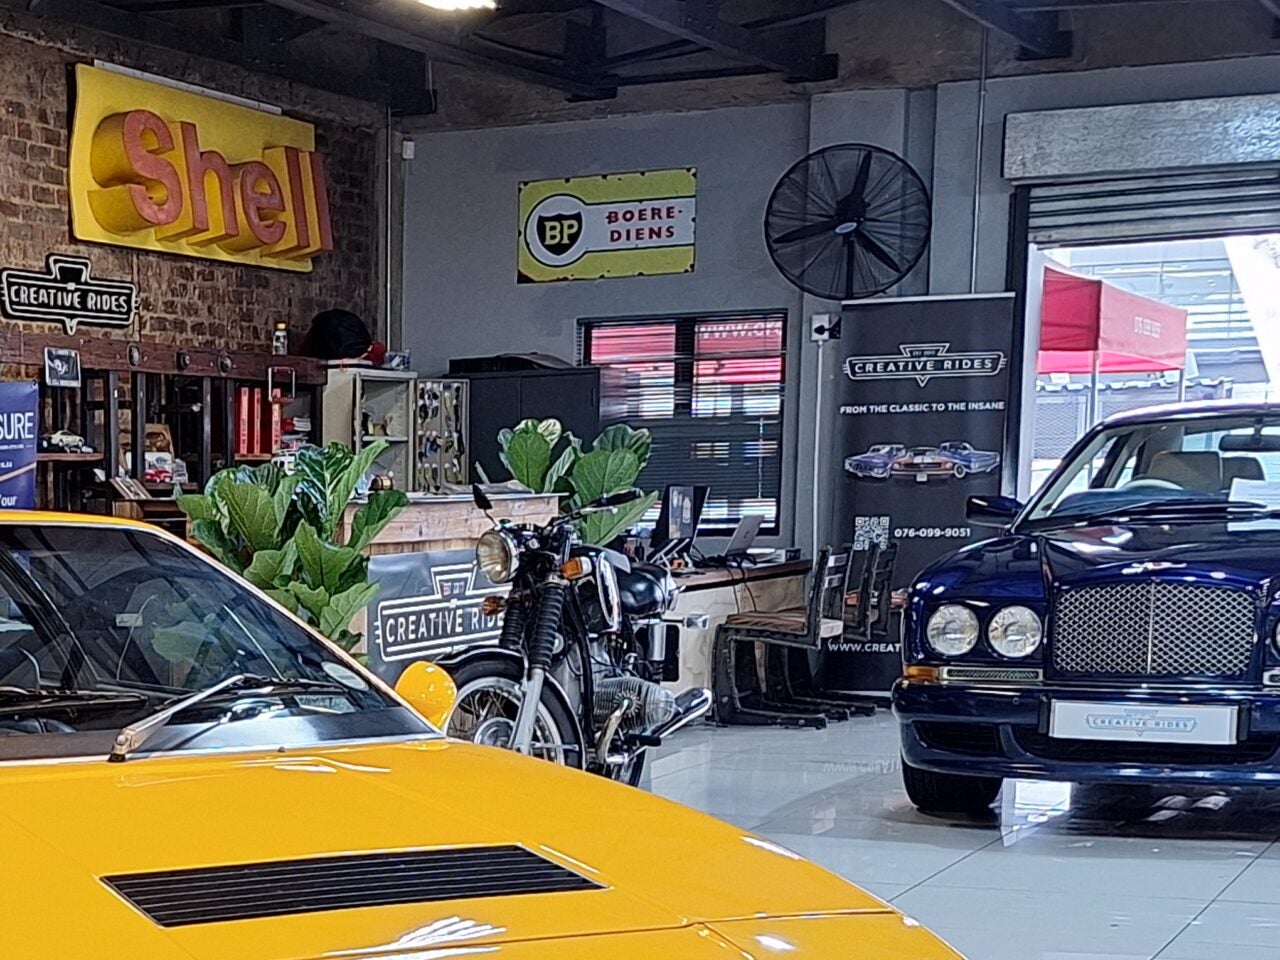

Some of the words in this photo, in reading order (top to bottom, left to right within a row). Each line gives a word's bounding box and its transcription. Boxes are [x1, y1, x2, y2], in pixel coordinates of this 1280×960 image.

[122, 109, 334, 252] Shell
[543, 220, 579, 246] BP
[610, 226, 675, 243] DIENS
[10, 285, 81, 309] CREATIVE
[87, 292, 128, 313] RIDES
[854, 360, 934, 373] CREATIVE
[943, 359, 993, 370] RIDES
[840, 405, 867, 414] FROM
[869, 405, 888, 413] THE
[889, 403, 930, 412] CLASSIC
[932, 403, 945, 411] TO
[947, 402, 966, 411] THE
[968, 401, 1005, 410] INSANE
[894, 528, 971, 538] 076-099-9051
[385, 609, 464, 643] CREATIVE
[471, 607, 505, 630] RIDE
[1093, 719, 1148, 727] CREATIVE
[1154, 721, 1189, 729] RIDES
